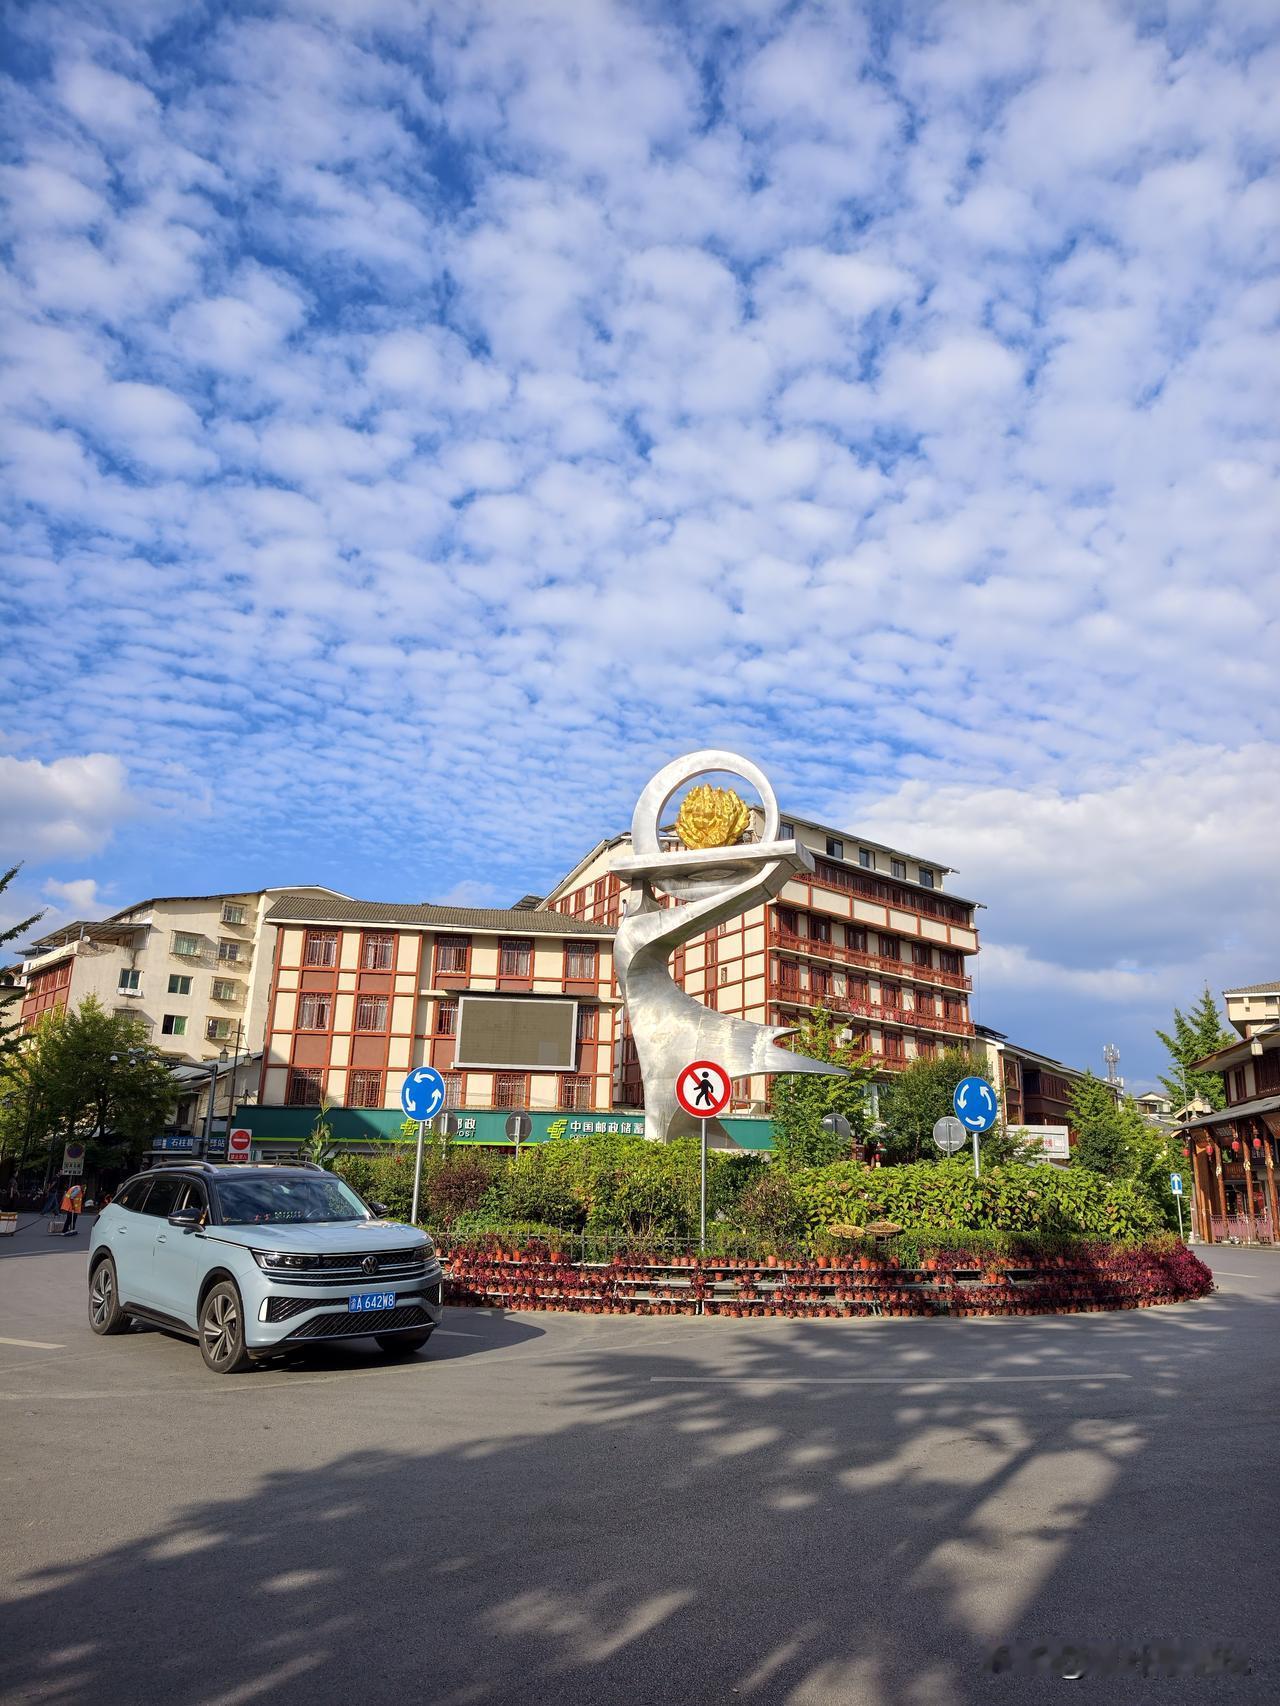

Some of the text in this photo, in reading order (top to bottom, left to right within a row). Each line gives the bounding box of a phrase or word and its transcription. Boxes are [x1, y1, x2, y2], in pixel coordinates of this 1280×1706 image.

[570, 1120, 644, 1134] 中国邮政储蓄
